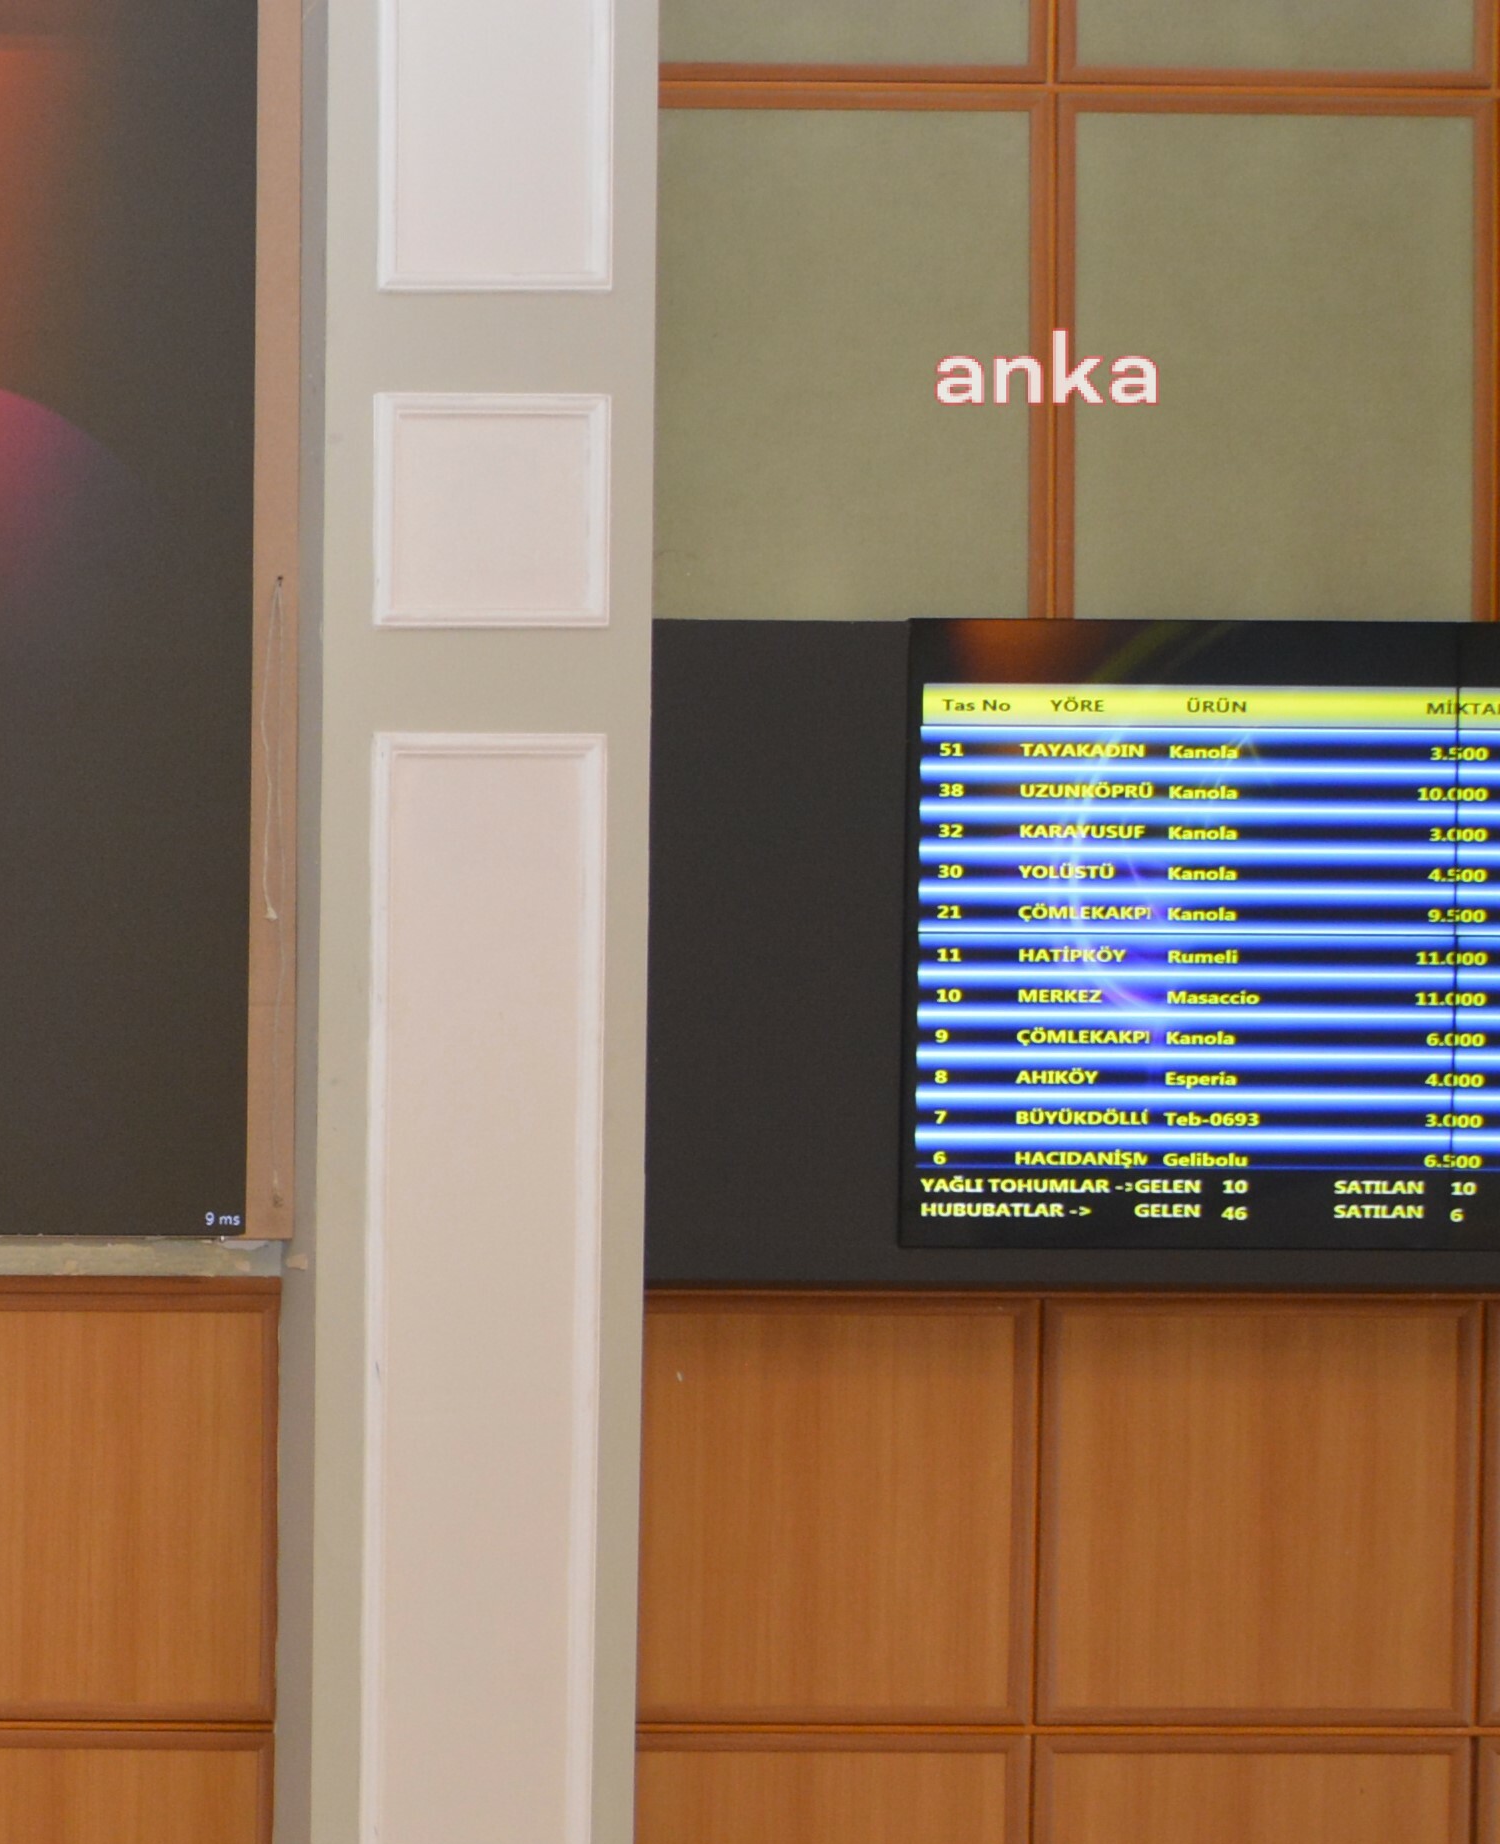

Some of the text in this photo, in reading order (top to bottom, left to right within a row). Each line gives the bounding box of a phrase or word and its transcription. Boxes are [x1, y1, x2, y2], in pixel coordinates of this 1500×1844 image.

[942, 697, 1500, 715] Tas No YÖRE ÜRÜN MİKTA
[939, 744, 1489, 761] 51 TAYAKADIN Kanola 3.500
[939, 782, 1489, 801] 38 UZUNKÖPRÜ Kanola 10.000
[938, 825, 1489, 842] 32 KARAYUSUF Kanola 3.000
[938, 863, 1488, 882] 30 YOLÜSTÜ Kanola 4.500
[937, 947, 1488, 966] 11 HATİPKÖY Rumeli 11.000
[937, 990, 1487, 1006] 10 MERKEZ Masaccio 11.000
[935, 1069, 1485, 1088] 8 AHIKÖY Esperia 4.000
[933, 1152, 946, 1165] 6
[1163, 1153, 1248, 1168] Gelibolu
[1424, 1155, 1483, 1169] 6.500
[921, 1176, 983, 1193] YAĞLI
[987, 1179, 1109, 1193] TOHUMLAR
[1135, 1180, 1200, 1194] GELEN
[1223, 1181, 1248, 1194] 10
[1334, 1181, 1425, 1194] SATILAN
[1451, 1182, 1477, 1195] 10
[205, 1211, 241, 1225] 9 ms
[920, 1203, 1064, 1217] HUBUBATLAR
[1135, 1205, 1200, 1218] GELEN
[1222, 1207, 1248, 1220] 46
[1334, 1205, 1424, 1218] SATILAN
[1450, 1209, 1464, 1222] 6
